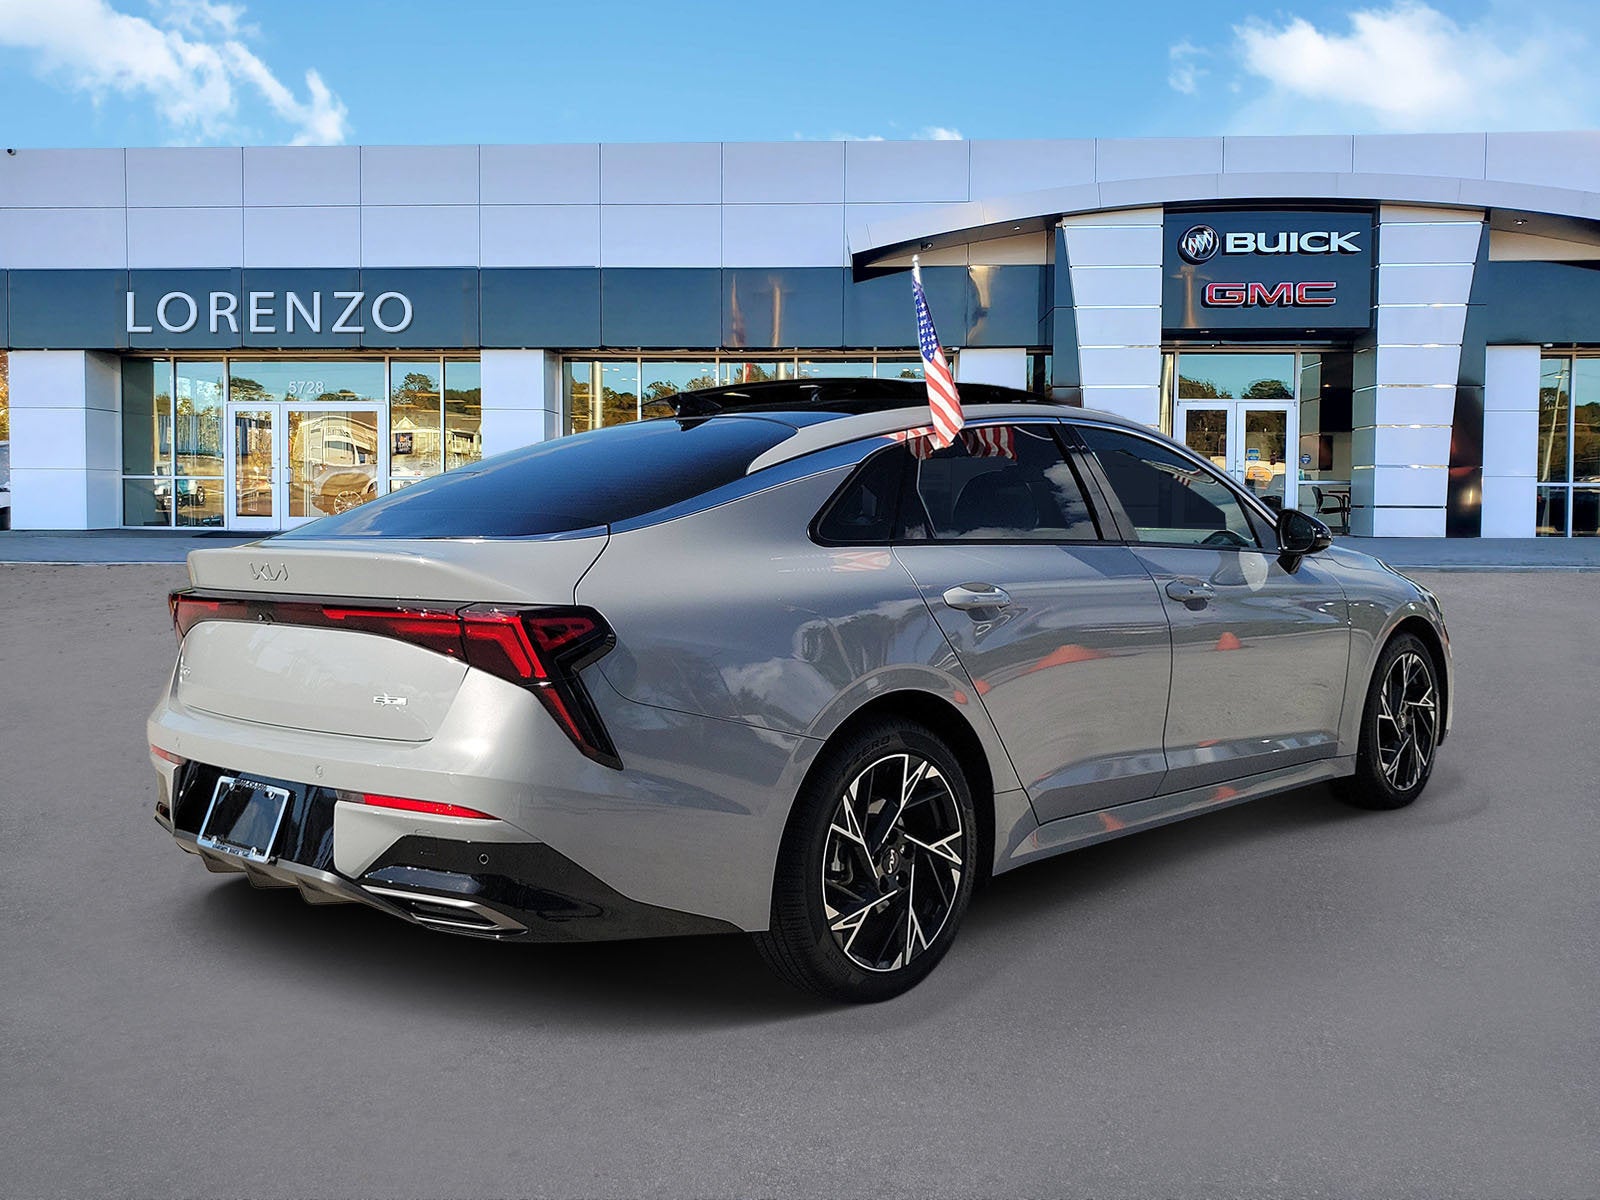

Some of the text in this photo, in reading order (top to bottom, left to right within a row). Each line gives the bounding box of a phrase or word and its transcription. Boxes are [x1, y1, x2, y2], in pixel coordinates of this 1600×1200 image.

[1225, 231, 1361, 253] BUICK
[1206, 282, 1337, 305] GMC
[126, 291, 414, 333] LORENZO
[288, 380, 325, 394] 5728
